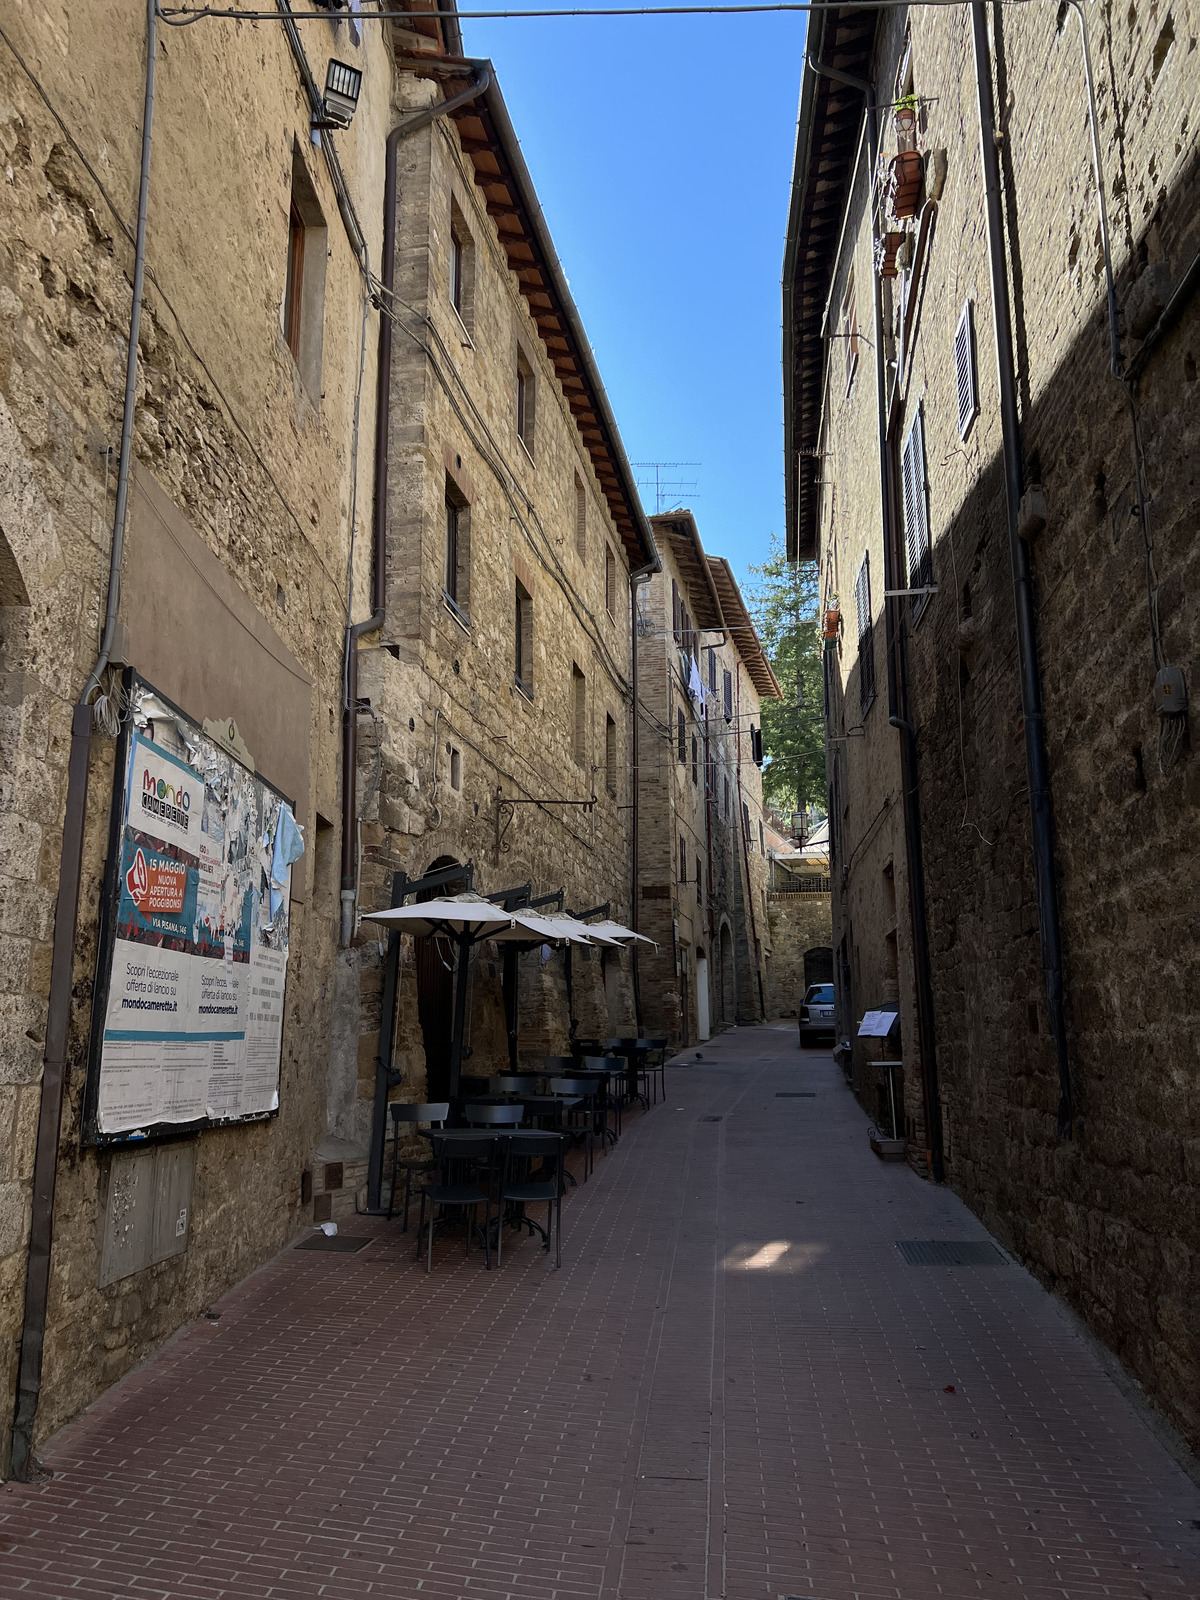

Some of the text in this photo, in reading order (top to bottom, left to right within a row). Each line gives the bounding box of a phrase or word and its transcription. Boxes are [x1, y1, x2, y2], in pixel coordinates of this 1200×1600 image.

[142, 792, 189, 830] CAMERETTE
[149, 858, 157, 872] 15
[158, 859, 186, 875] MAGGIO
[157, 875, 177, 886] NUOVA
[149, 886, 183, 897] APERTURA A
[148, 897, 182, 909] POGGIBONSI
[152, 917, 161, 928] VIA
[161, 920, 179, 933] PISANA,
[126, 962, 179, 981] Scopri l'eccezionale
[126, 979, 177, 996] offerta di lancio su
[201, 974, 214, 987] Scopri
[201, 988, 238, 1001] offerta di lancio su
[121, 997, 178, 1012] mondocamerette.it
[198, 1004, 239, 1015] mondocamerette.it
